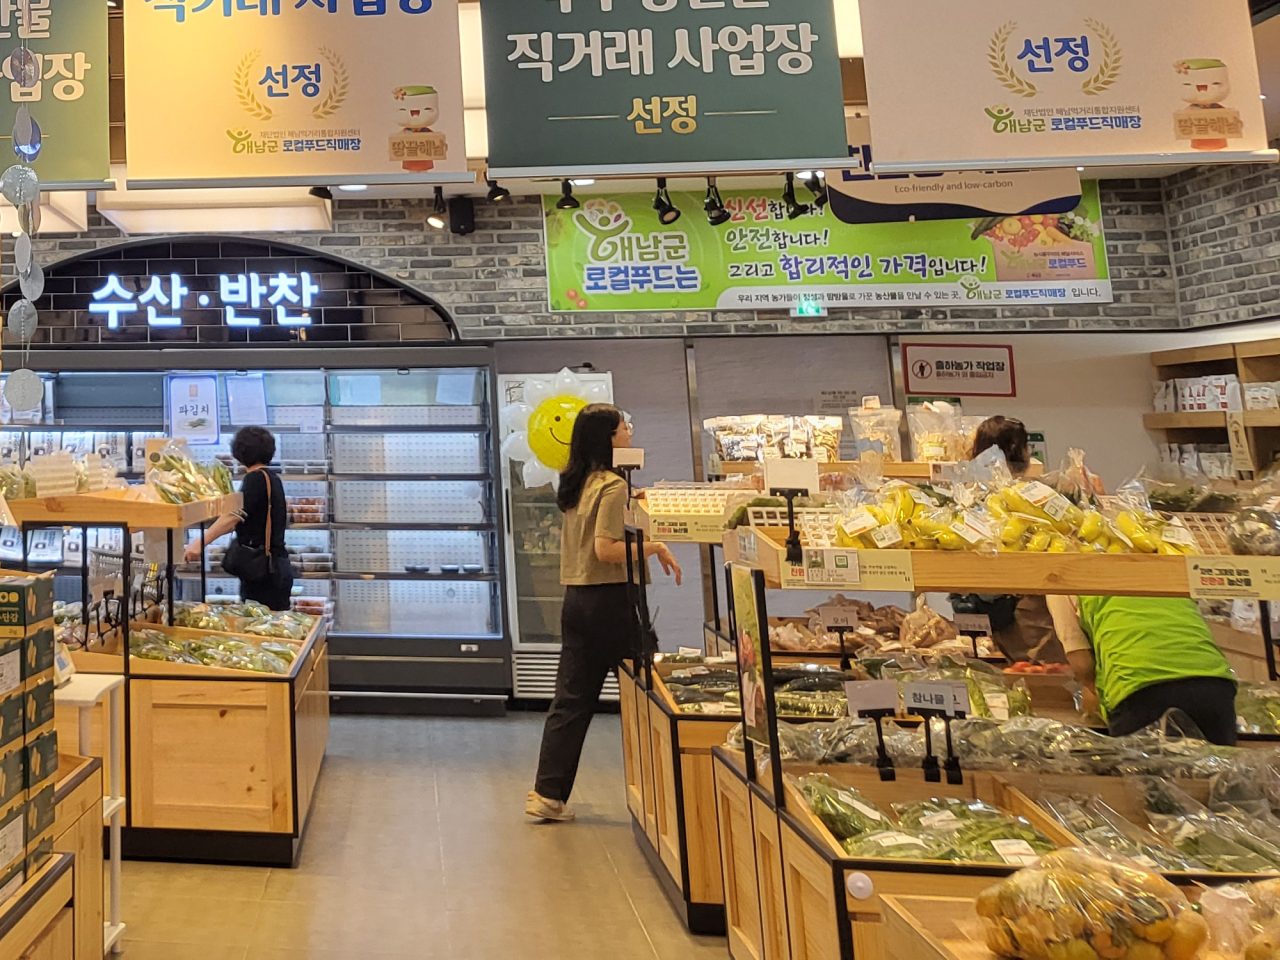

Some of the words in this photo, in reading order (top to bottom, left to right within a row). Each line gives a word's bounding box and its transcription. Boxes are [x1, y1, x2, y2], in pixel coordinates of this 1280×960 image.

[507, 28, 653, 82] 직거래
[667, 22, 818, 76] 사업장
[1017, 36, 1088, 73] 선정
[258, 64, 321, 98] 선정
[626, 95, 697, 134] 선정
[895, 182, 944, 193] Eco-friendly
[946, 182, 962, 190] and
[965, 180, 1013, 189] low-carbon
[726, 228, 829, 251] 안전합니다!
[586, 265, 698, 291] 로컬푸드는
[729, 263, 774, 278] 그리고
[780, 254, 872, 281] 합리적인
[880, 254, 987, 279] 가격입니다!
[755, 294, 770, 302] 지역
[934, 291, 949, 299] 있는
[1071, 288, 1102, 297] 입니다.
[912, 692, 944, 705] 참나물
